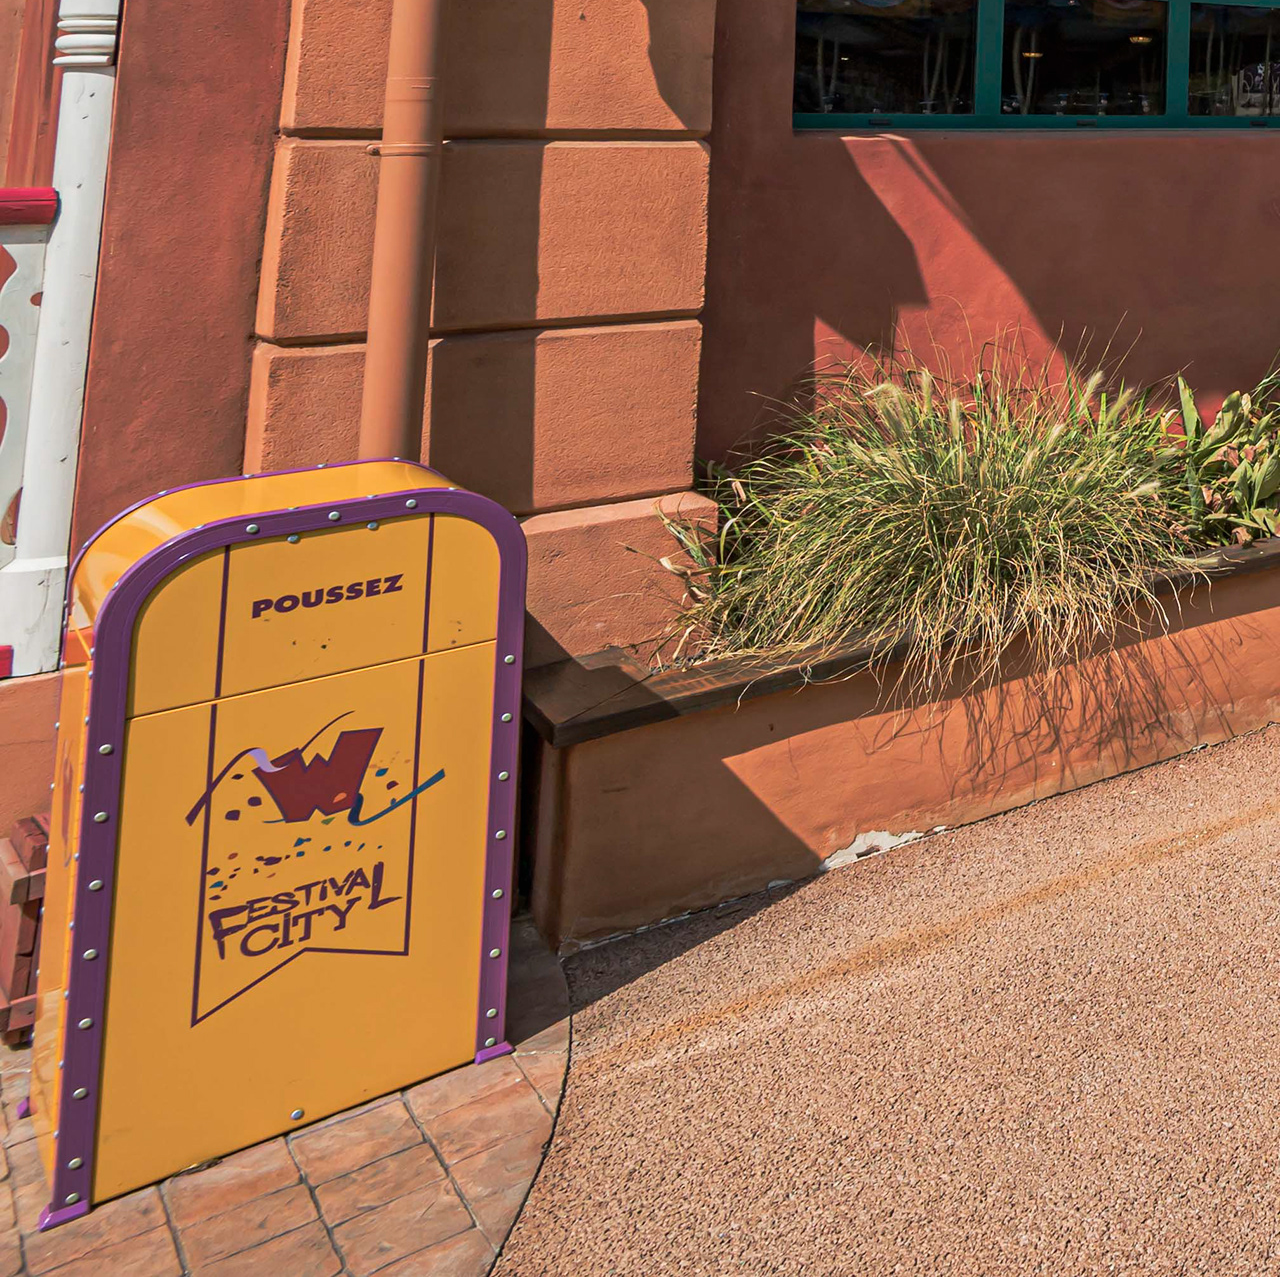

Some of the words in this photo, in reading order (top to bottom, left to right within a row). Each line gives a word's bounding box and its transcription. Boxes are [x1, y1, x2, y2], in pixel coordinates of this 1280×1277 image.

[251, 574, 404, 619] POUSSEZ
[208, 861, 403, 960] FESTIVAL
[239, 896, 361, 957] CITY
